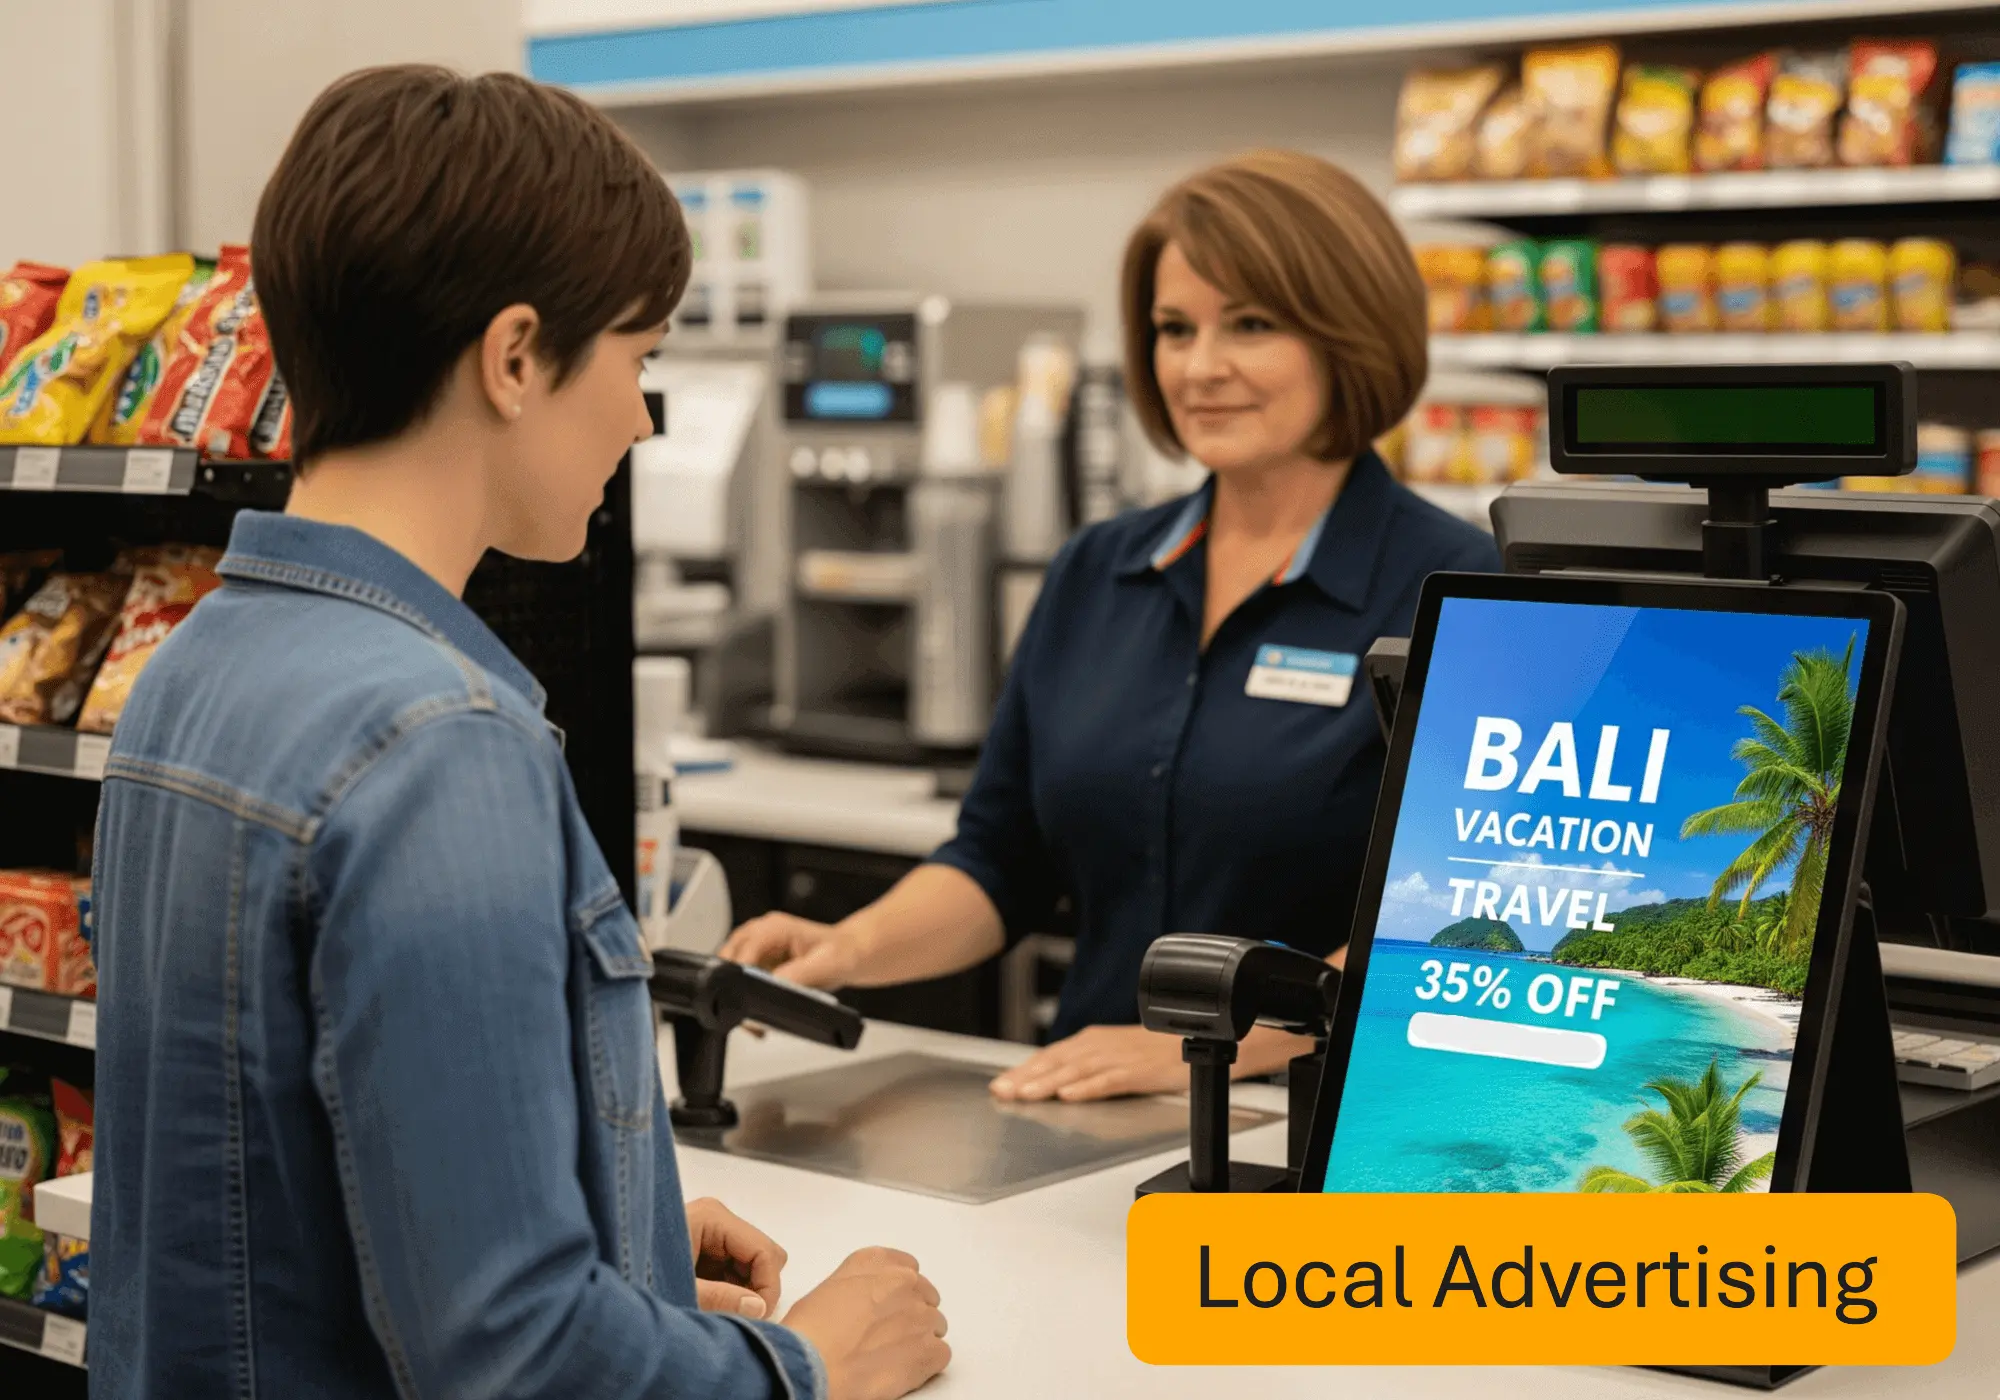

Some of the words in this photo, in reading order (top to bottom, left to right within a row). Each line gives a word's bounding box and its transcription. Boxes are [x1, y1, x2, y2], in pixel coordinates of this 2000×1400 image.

[1462, 715, 1670, 804] BALI
[1454, 807, 1654, 858] VACATION
[1447, 876, 1615, 932] TRAVEL
[1414, 959, 1512, 1009] 35%
[1527, 973, 1620, 1020] OFF
